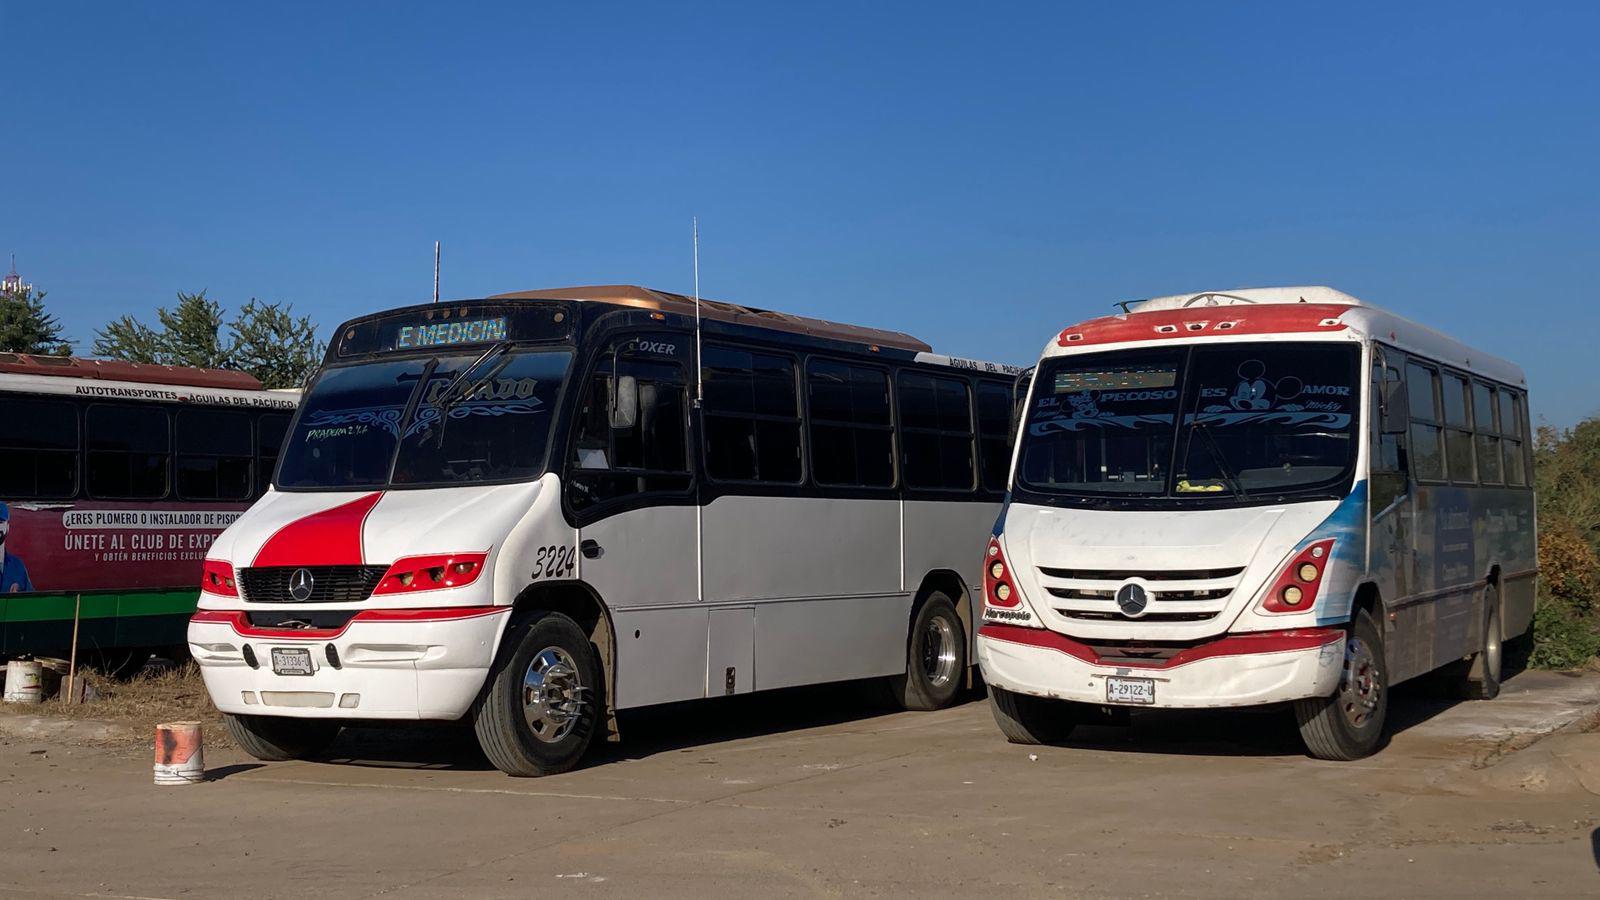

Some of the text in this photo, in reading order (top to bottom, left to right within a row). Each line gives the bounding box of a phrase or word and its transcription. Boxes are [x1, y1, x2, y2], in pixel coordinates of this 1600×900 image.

[416, 318, 507, 345] MEDICIN
[631, 341, 677, 356] OXER
[984, 362, 998, 372] DEL
[75, 385, 178, 400] AUTOTRANSPORTES
[232, 396, 251, 407] DEL
[1200, 384, 1351, 398] ES AMOR
[1037, 389, 1178, 409] EL PECOSO
[65, 513, 93, 527] ¿ERES
[96, 512, 139, 525] PLOMERO
[141, 513, 148, 525] O
[149, 512, 202, 525] INSTALADOR
[204, 512, 215, 525] DE
[64, 530, 105, 550] ÚNETE
[110, 534, 126, 550] AL
[131, 534, 164, 550] CLUB
[169, 533, 184, 550] DE
[94, 552, 100, 562] Y
[103, 550, 129, 562] OBTÉN
[131, 551, 178, 562] BENEFICIOS
[531, 545, 576, 579] 3224
[1108, 684, 1153, 696] A-29122-U
